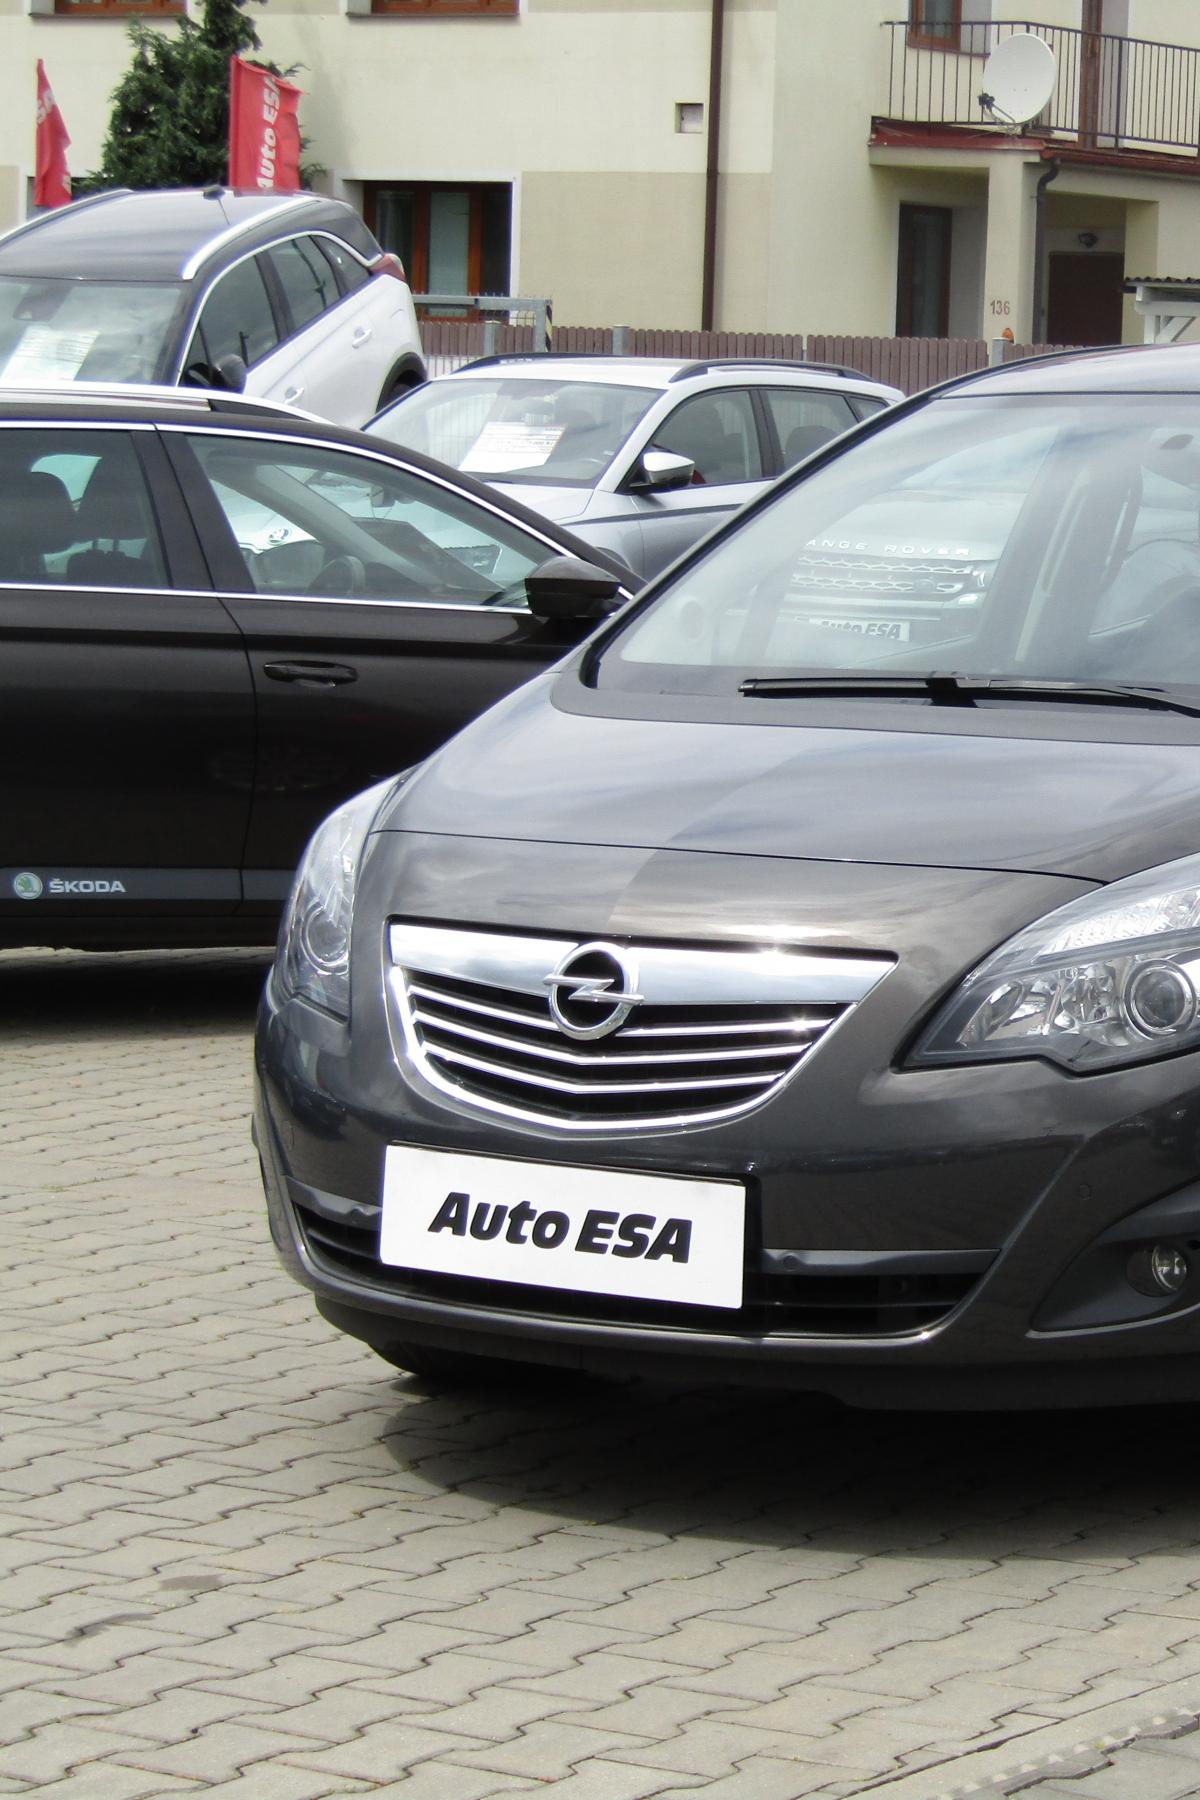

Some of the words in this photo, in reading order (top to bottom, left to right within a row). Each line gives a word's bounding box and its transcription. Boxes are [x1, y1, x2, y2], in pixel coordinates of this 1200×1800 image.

[990, 299, 1010, 316] 136
[805, 538, 869, 551] ANGE
[884, 544, 970, 556] ROVER
[49, 878, 126, 893] ŠKODA
[427, 1191, 571, 1250] Auto
[574, 1209, 693, 1264] ESA
